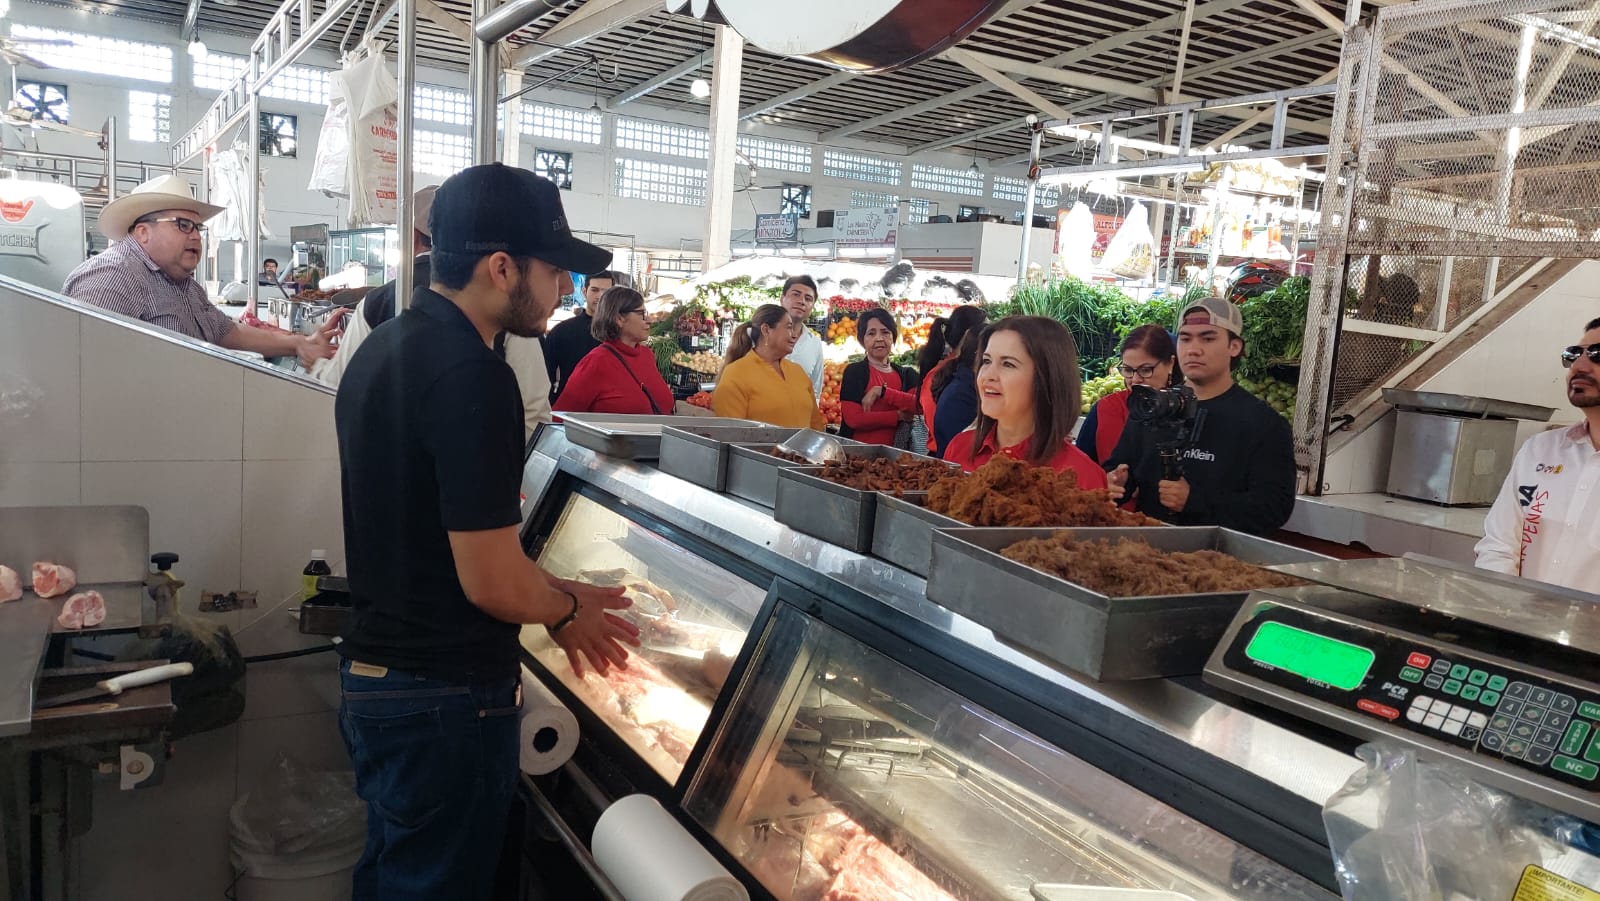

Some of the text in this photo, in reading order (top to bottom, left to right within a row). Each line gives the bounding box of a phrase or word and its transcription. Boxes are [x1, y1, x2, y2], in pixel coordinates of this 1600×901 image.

[1413, 656, 1426, 664] ON
[1403, 670, 1419, 679] OFF
[1381, 682, 1409, 697] PCR
[1514, 686, 1523, 695] 7
[1537, 693, 1546, 702] 8
[1505, 703, 1515, 712] 4
[1560, 699, 1569, 709] 9
[1551, 717, 1560, 726] 6
[1487, 735, 1499, 745] C
[1542, 733, 1552, 743] 3
[1565, 761, 1584, 773] NC
